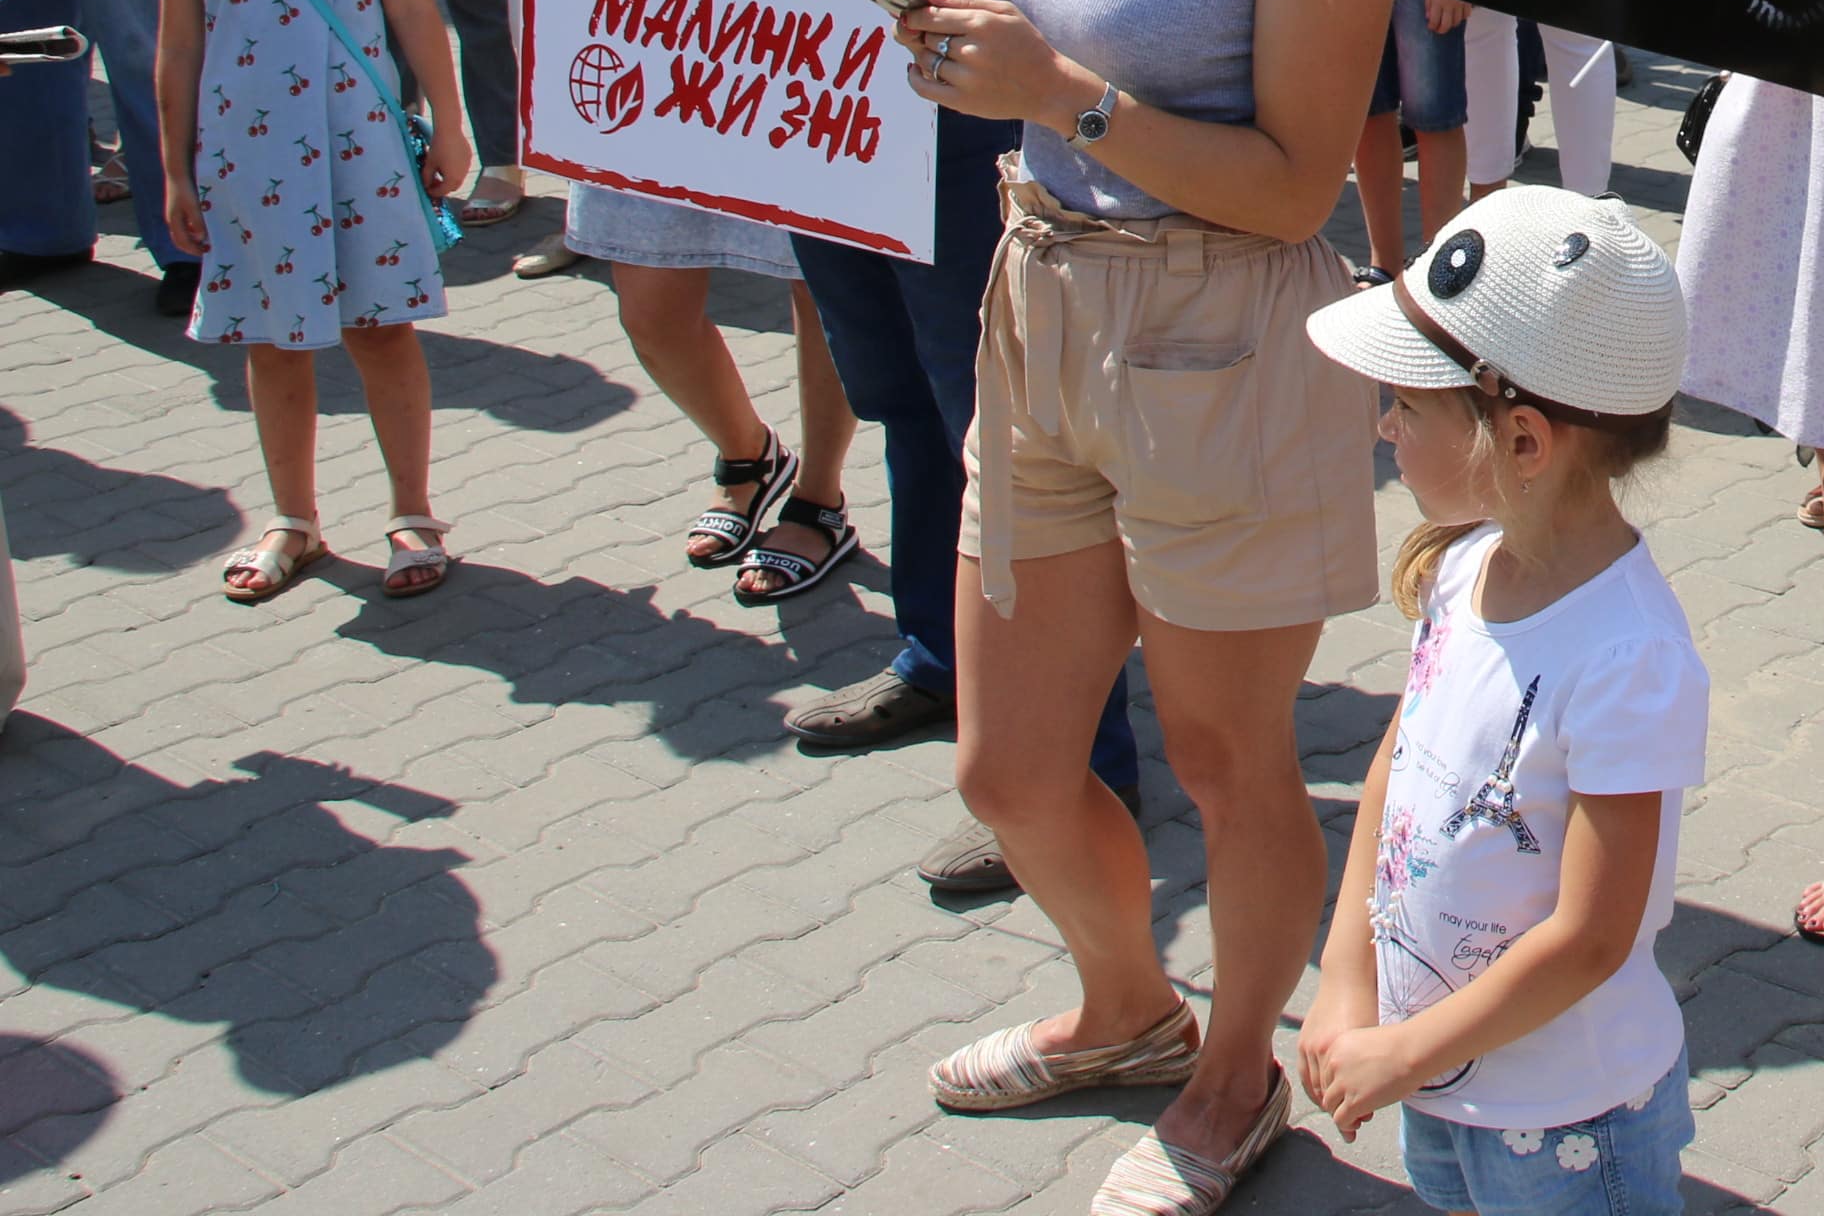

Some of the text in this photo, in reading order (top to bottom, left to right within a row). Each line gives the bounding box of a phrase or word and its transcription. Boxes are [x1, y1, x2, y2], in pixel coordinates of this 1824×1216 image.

[654, 53, 882, 163] ЖИЗНЬ
[1440, 911, 1507, 934] may your life
